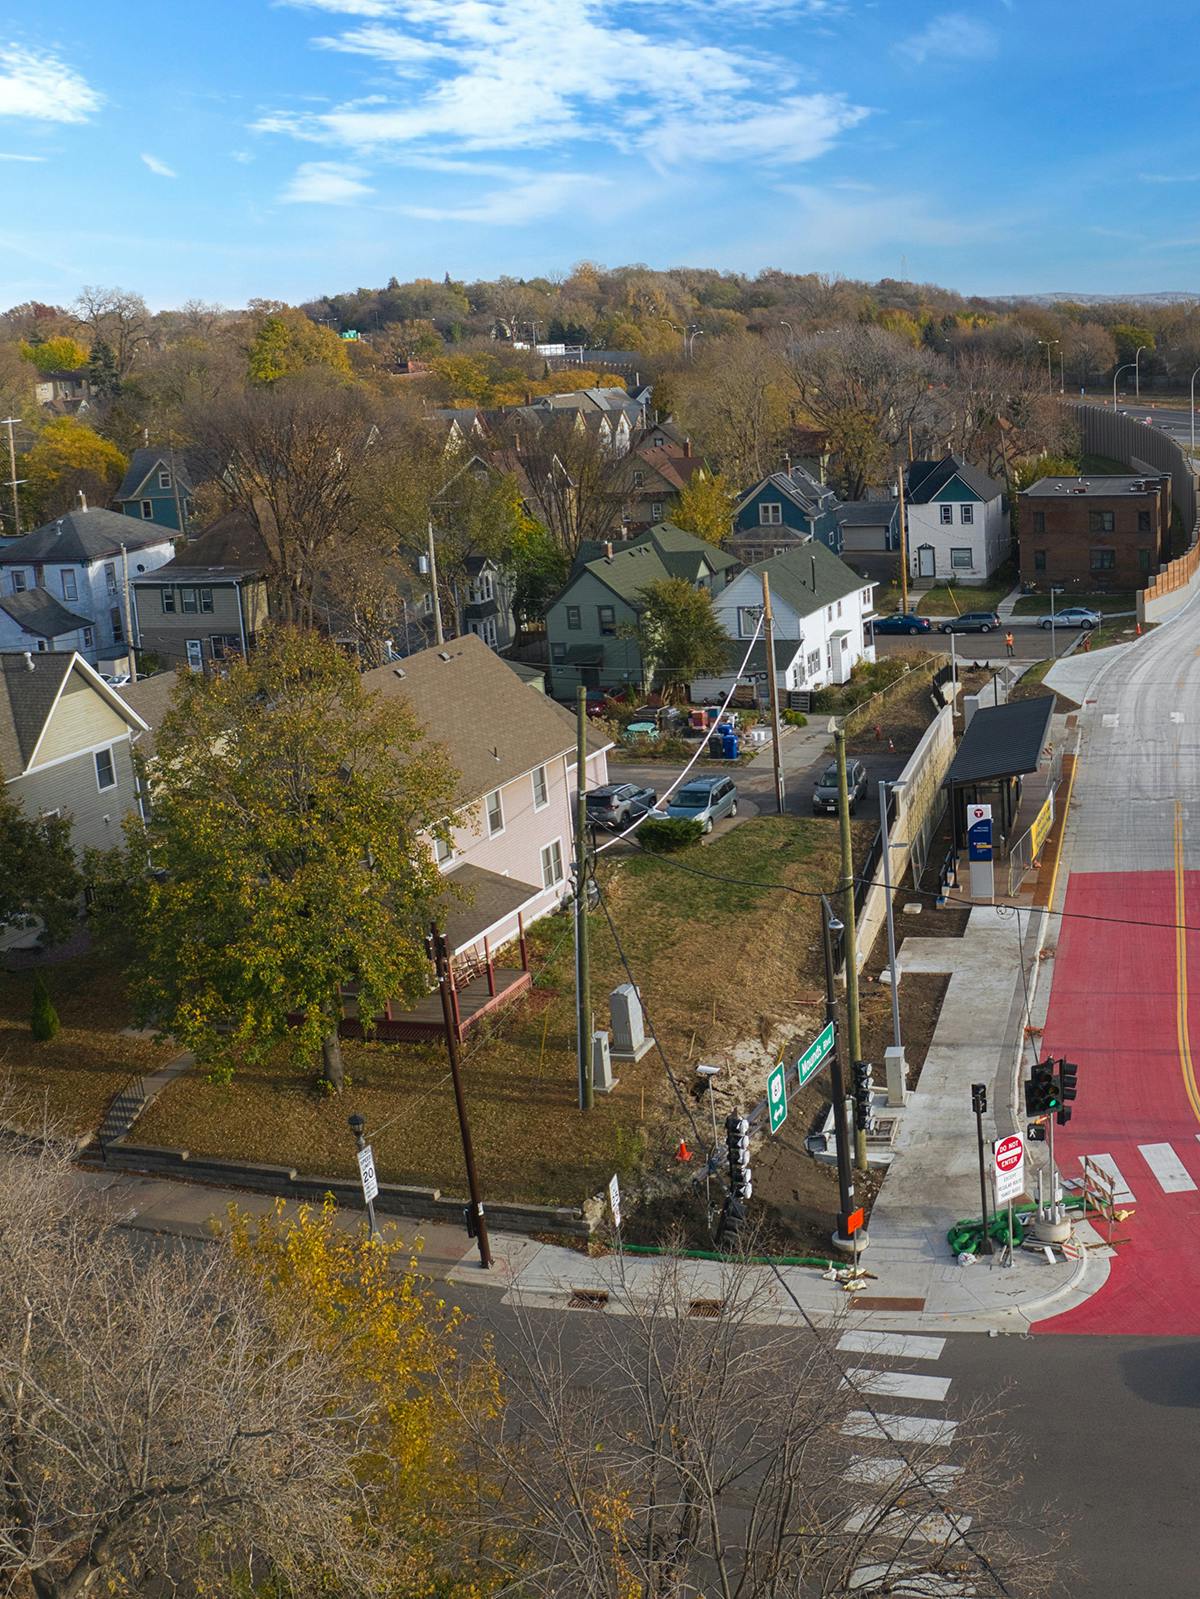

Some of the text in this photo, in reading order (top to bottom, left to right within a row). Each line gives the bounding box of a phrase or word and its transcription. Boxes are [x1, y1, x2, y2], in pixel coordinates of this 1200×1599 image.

[801, 1034, 832, 1076] Mounds Blvd
[999, 1140, 1019, 1153] DO NOT
[1001, 1156, 1018, 1168] ENTER
[363, 1167, 374, 1183] 20
